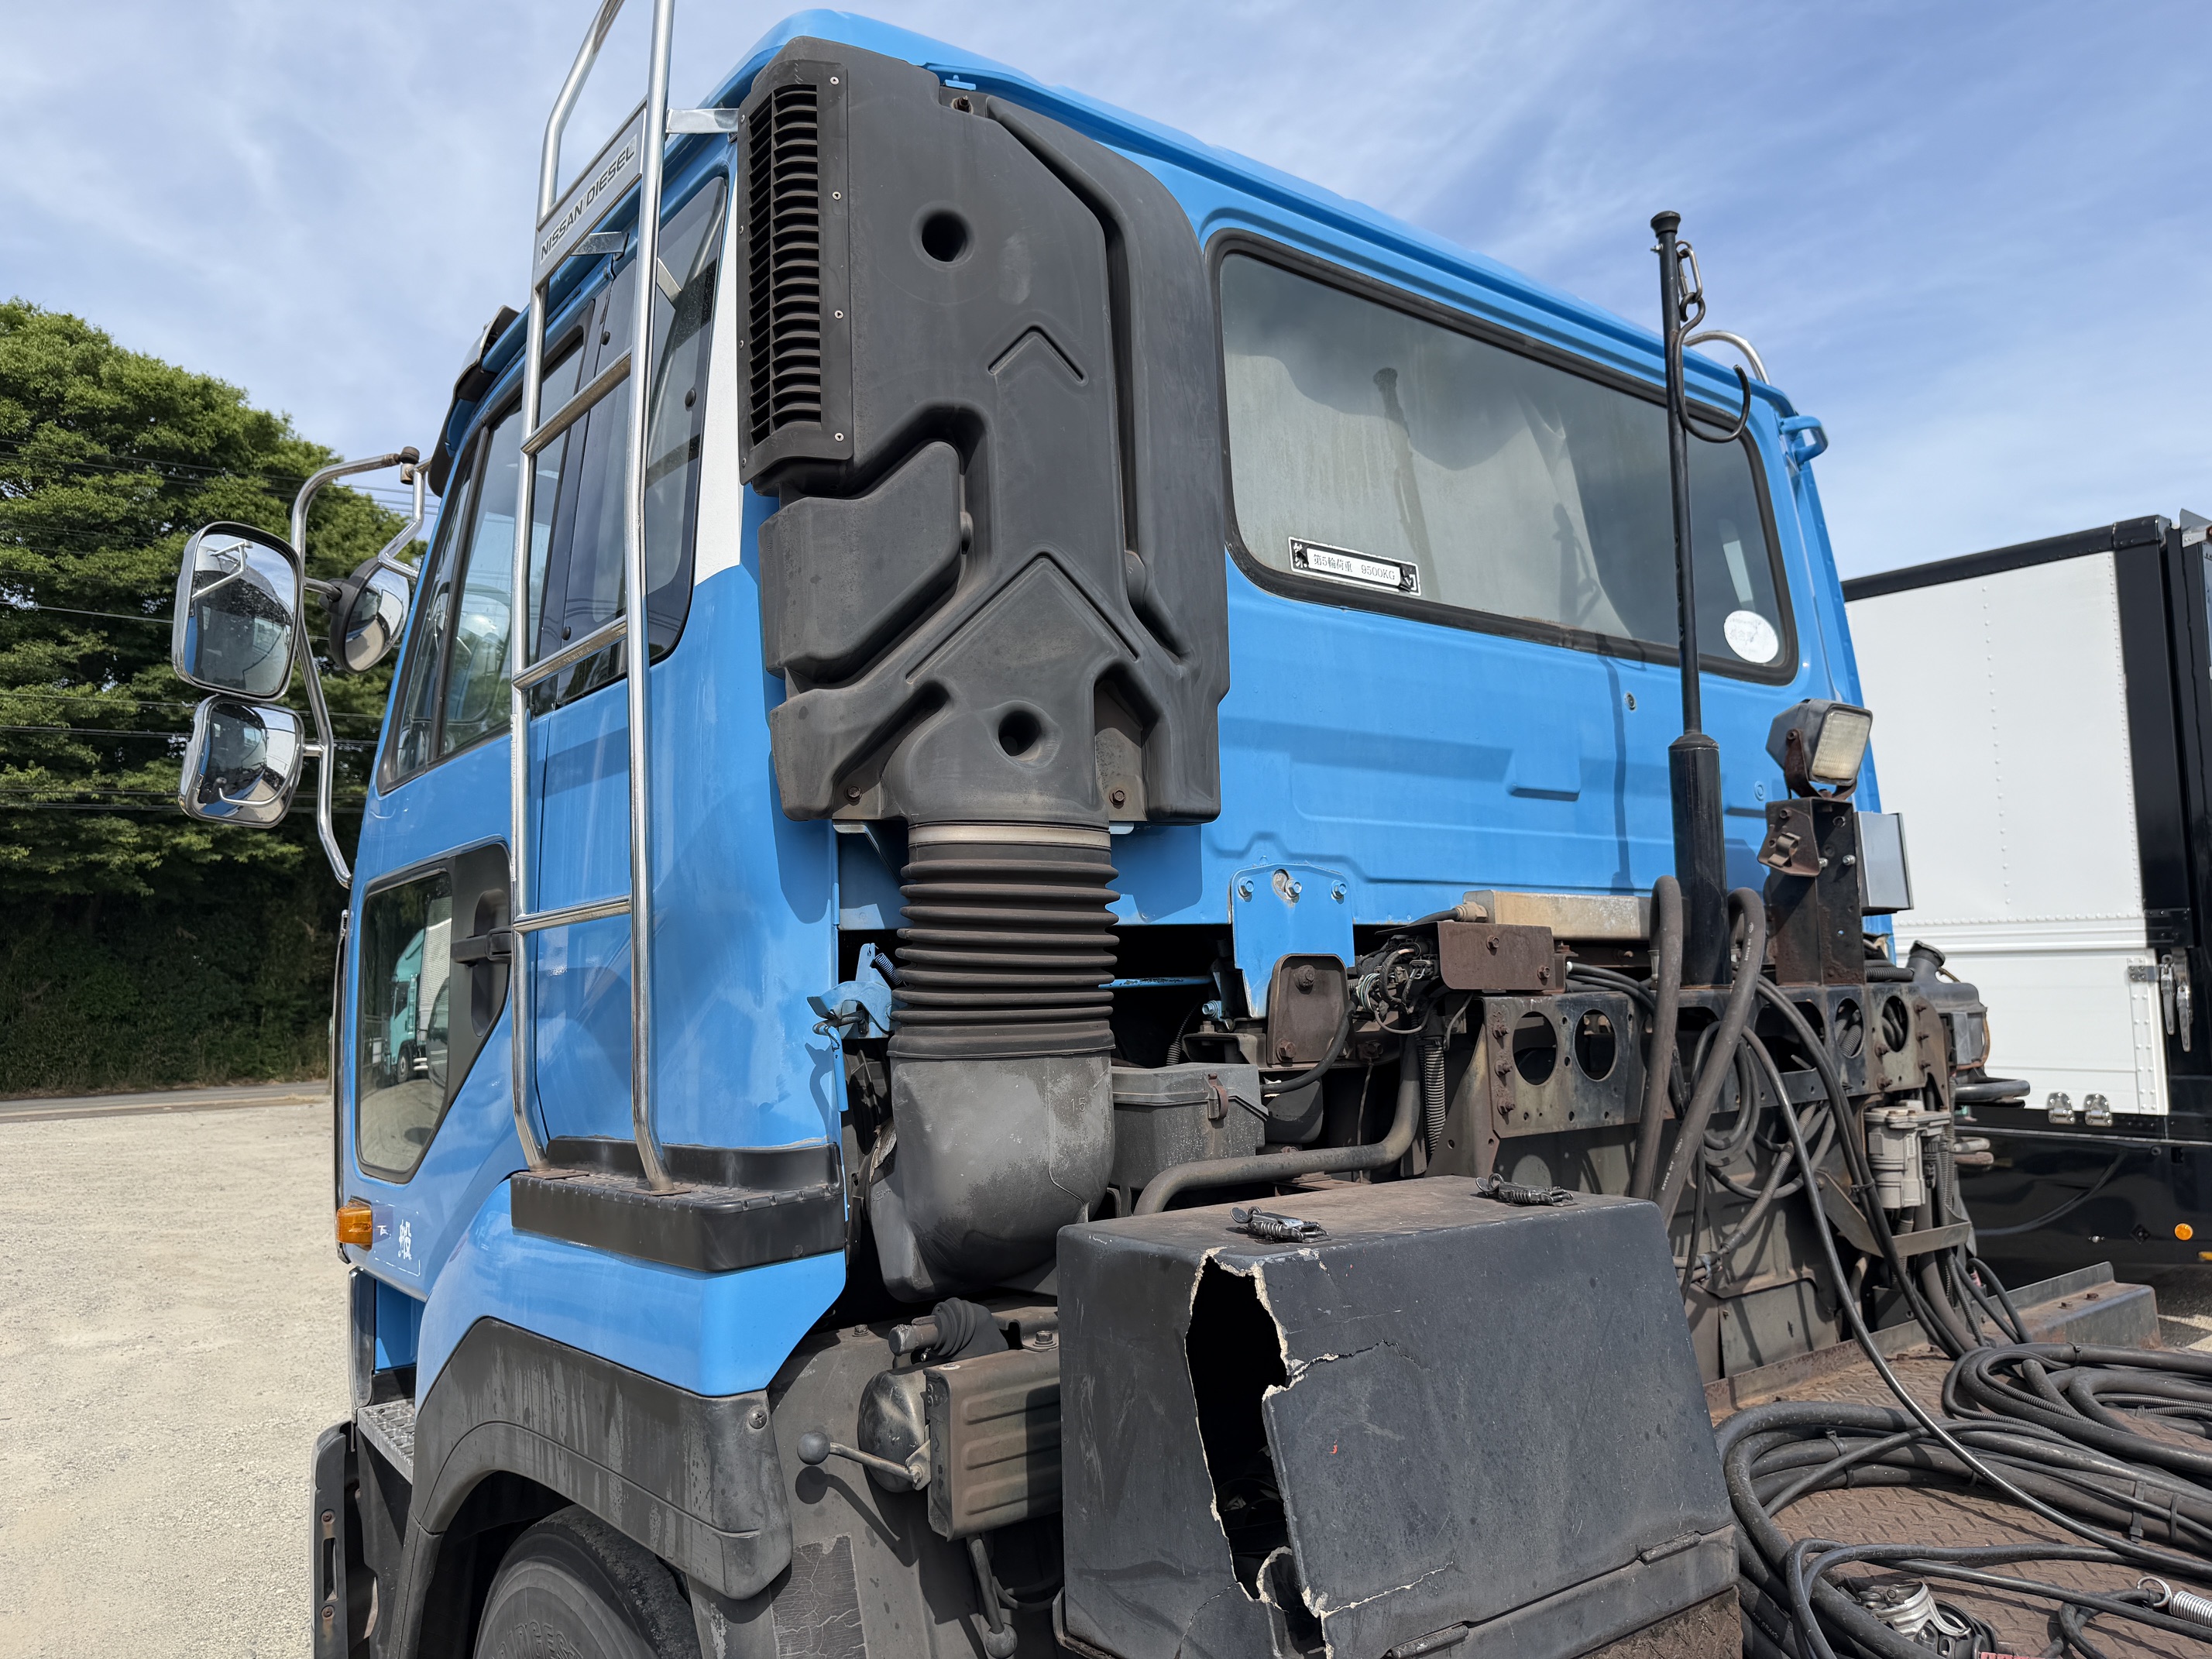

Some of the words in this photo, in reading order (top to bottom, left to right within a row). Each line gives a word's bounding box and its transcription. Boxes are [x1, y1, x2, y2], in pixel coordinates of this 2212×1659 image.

[541, 200, 583, 260] NISSAN
[586, 147, 635, 206] DIESEL
[1314, 554, 1353, 572] 第5輪荷重
[1361, 564, 1396, 580] 9500KG
[1661, 1172, 1670, 1190] BRAKE
